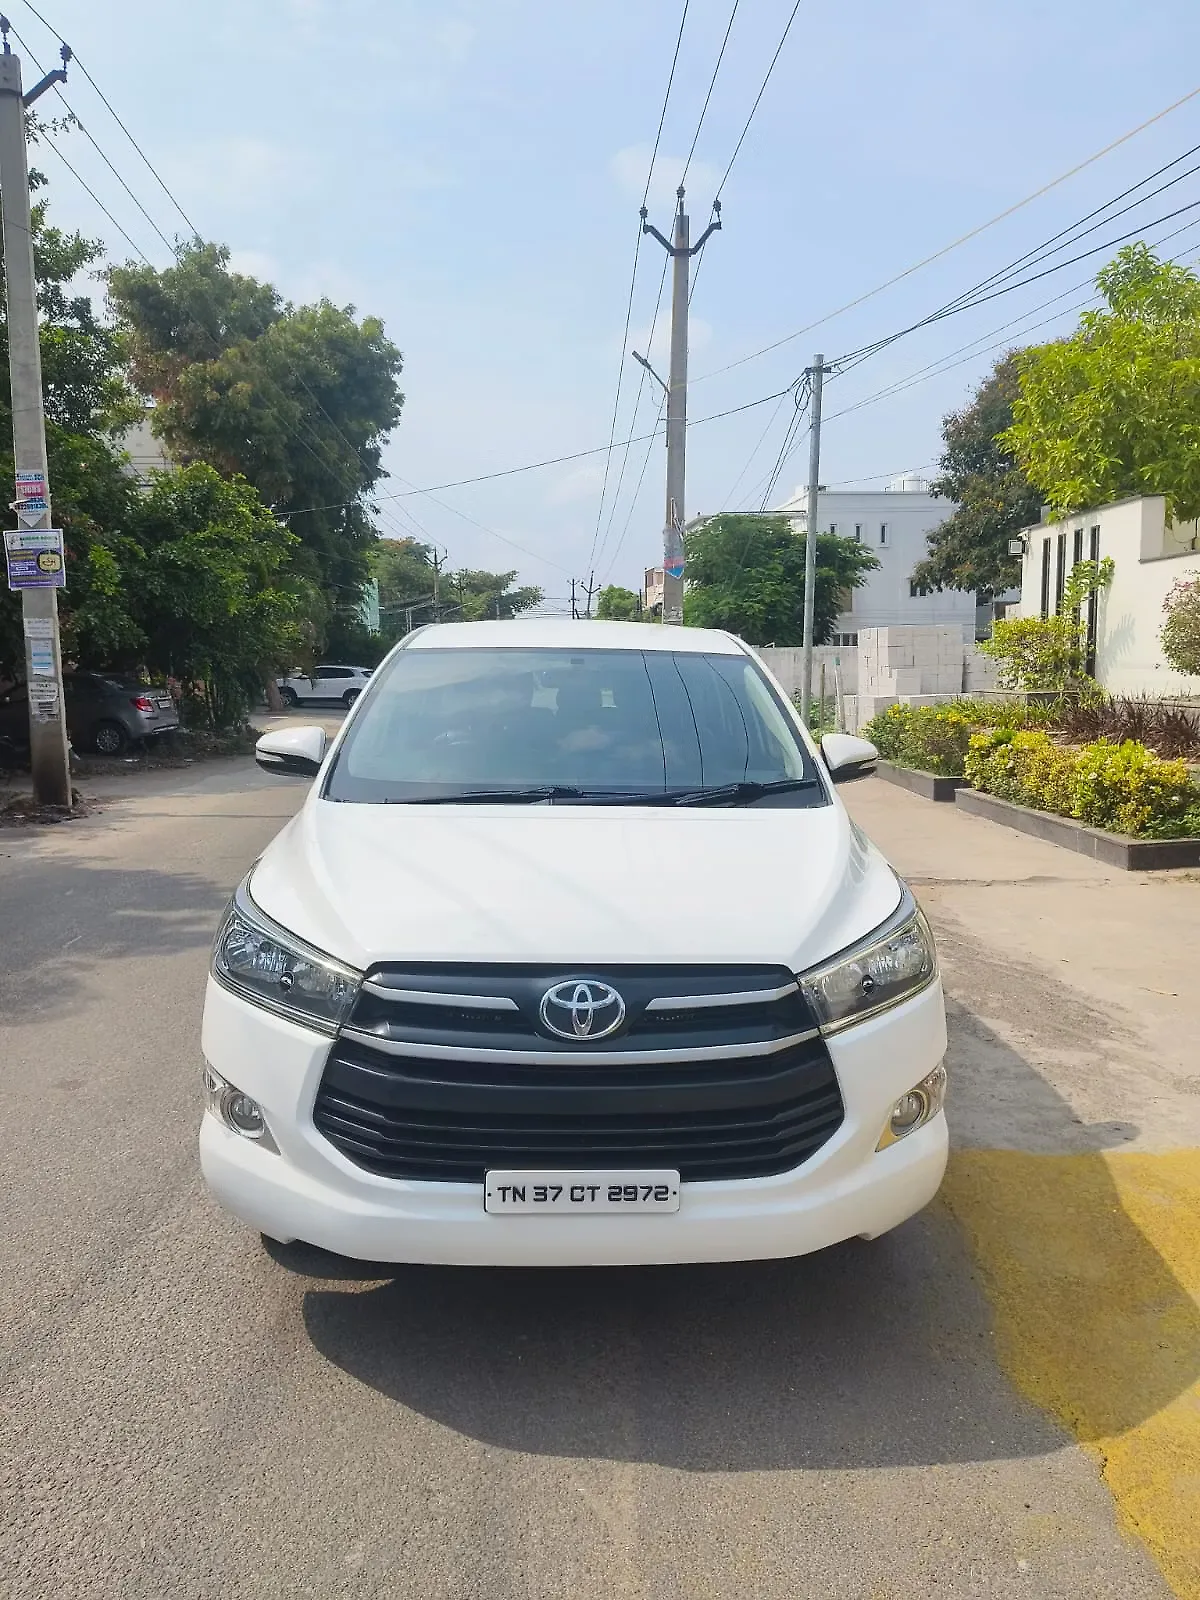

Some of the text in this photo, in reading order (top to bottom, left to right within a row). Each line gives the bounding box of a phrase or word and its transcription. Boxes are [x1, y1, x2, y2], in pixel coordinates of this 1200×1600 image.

[497, 1185, 669, 1202] TN 37 CT 2972
